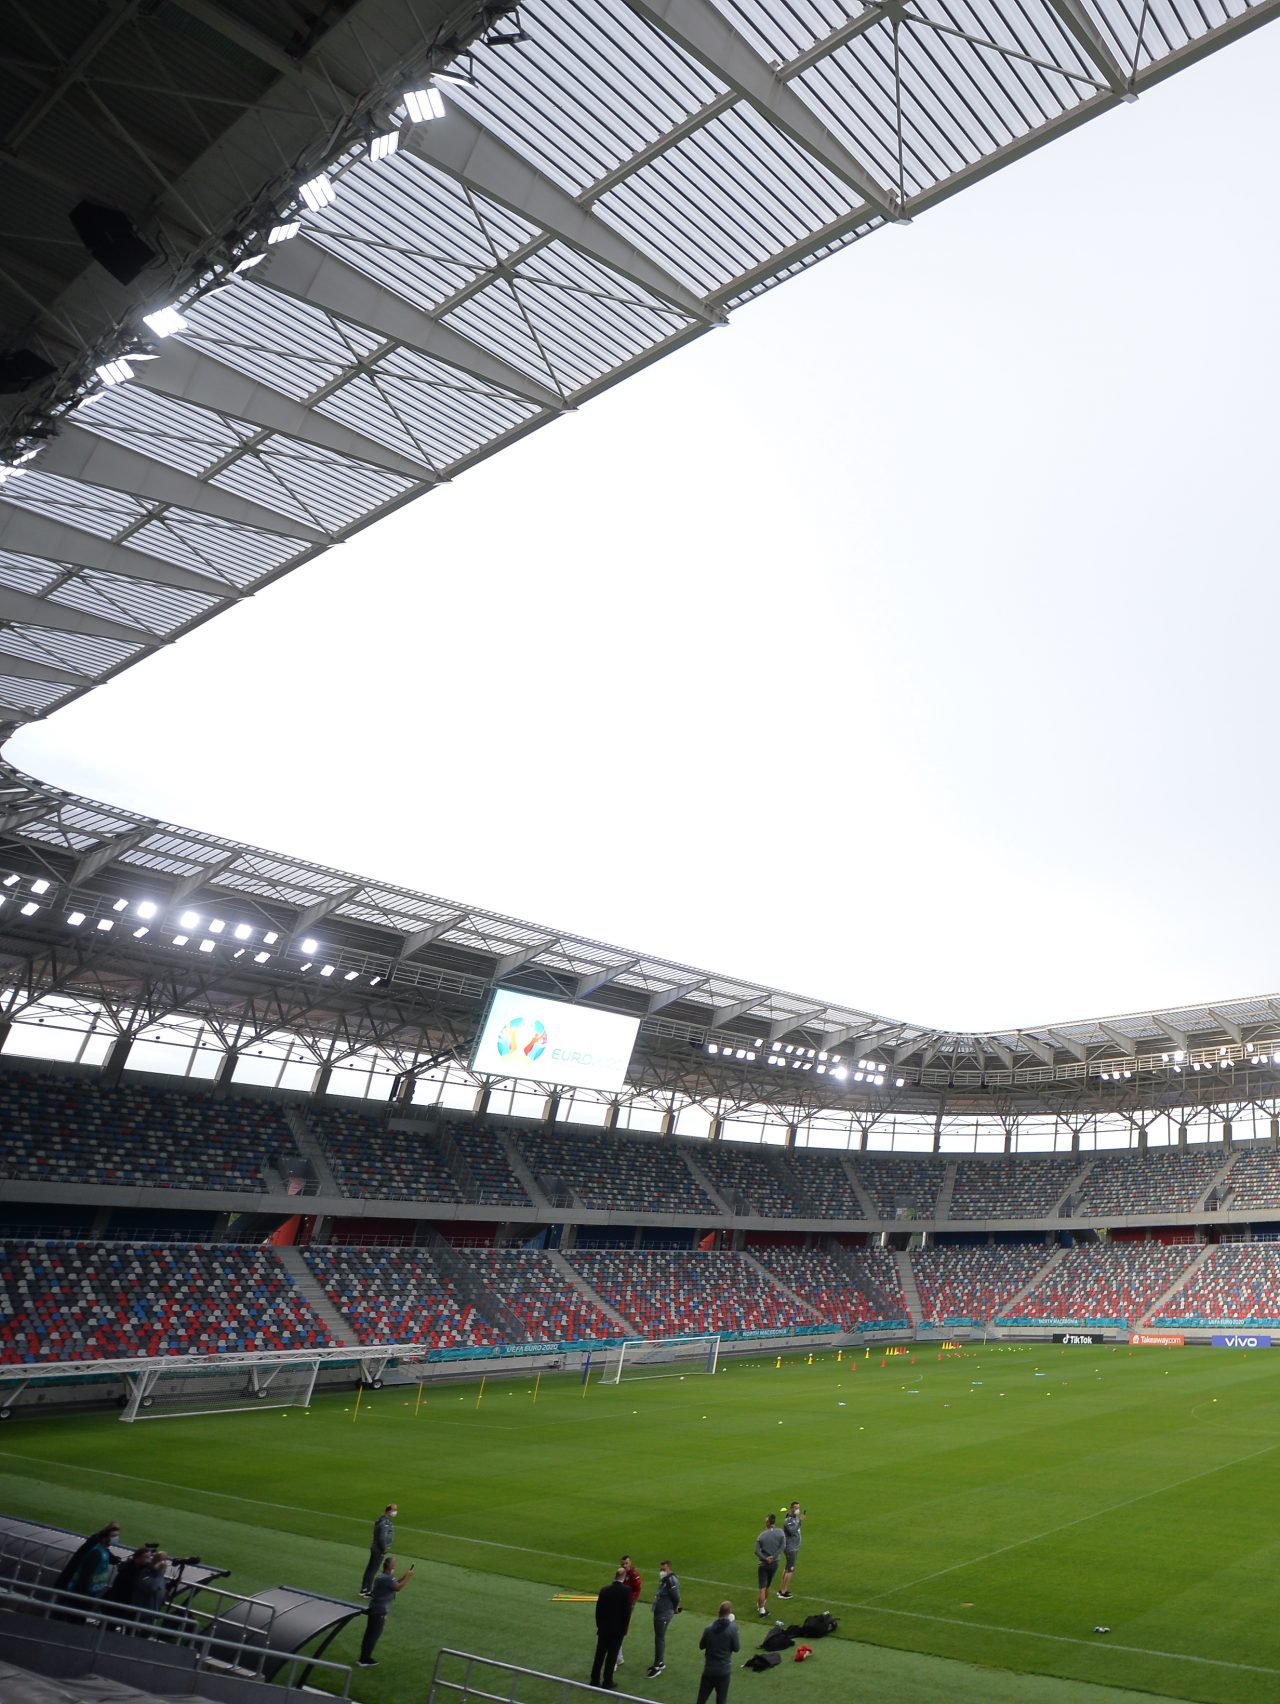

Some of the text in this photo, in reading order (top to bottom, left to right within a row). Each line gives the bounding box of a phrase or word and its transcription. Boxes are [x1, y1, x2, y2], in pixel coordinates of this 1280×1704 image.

[760, 1328, 787, 1336] MACEDONIA
[1070, 1335, 1092, 1344] TikTok
[1141, 1335, 1181, 1345] Takeaway.com
[1224, 1336, 1258, 1347] vivo
[506, 1343, 560, 1353] UEFA EURO 2020
